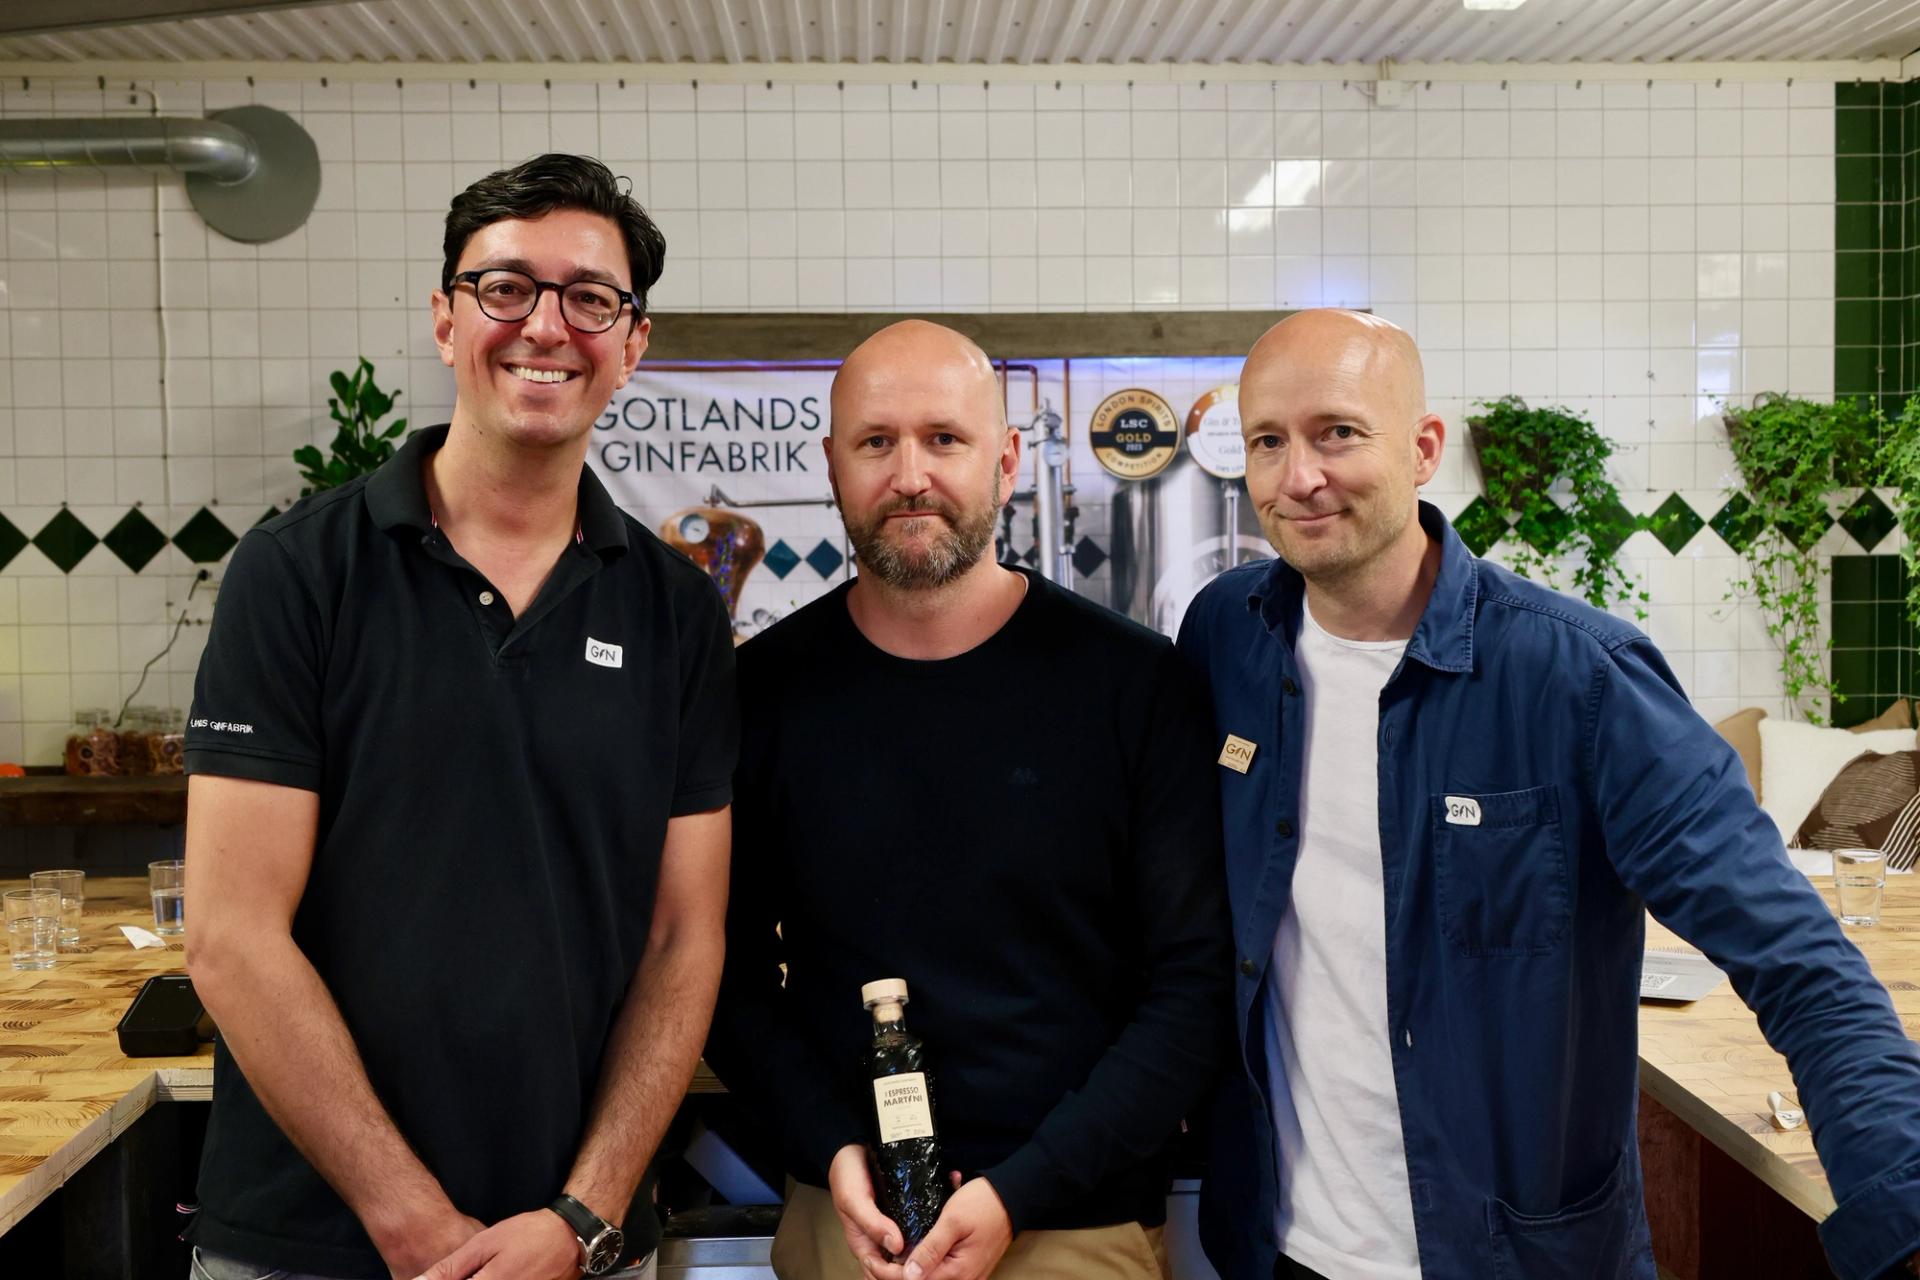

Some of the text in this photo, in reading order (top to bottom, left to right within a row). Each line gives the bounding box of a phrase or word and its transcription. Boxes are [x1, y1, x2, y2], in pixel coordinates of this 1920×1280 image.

[594, 397, 821, 431] GOTLANDS
[1096, 395, 1171, 427] LONDON SPIRITS
[1120, 419, 1148, 428] LSC
[1116, 433, 1152, 443] GOLD
[601, 441, 808, 473] GINFABRIK
[1106, 452, 1163, 470] COMPETITION
[888, 1086, 919, 1097] ESPRESSO
[883, 1094, 923, 1107] MARTINI
